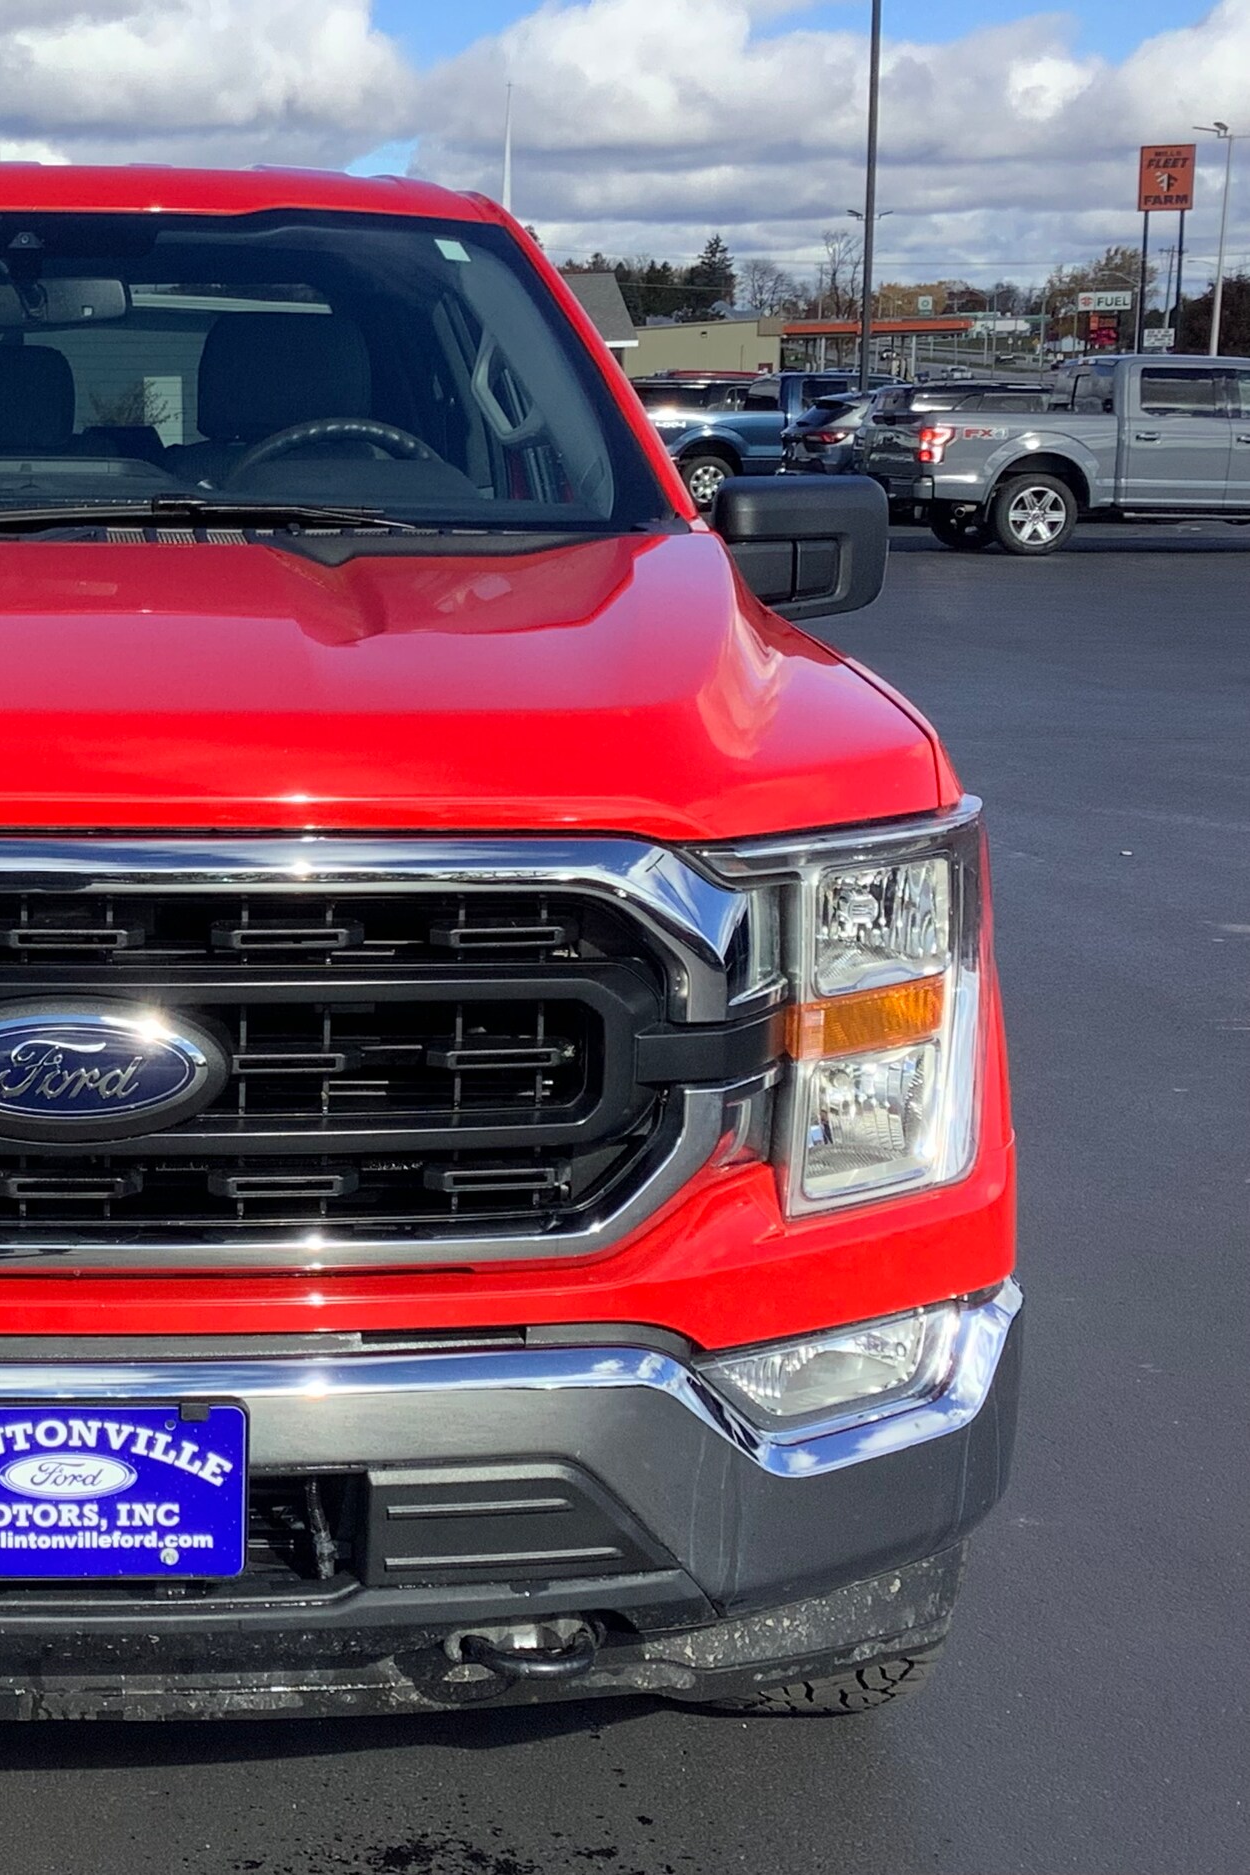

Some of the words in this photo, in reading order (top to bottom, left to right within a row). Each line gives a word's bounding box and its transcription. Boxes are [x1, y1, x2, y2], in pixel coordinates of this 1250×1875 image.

[1147, 157, 1189, 168] FLEET
[1144, 194, 1187, 206] FARM
[1097, 296, 1129, 307] FUEL
[964, 428, 1008, 439] FX4
[30, 1461, 104, 1488] Ford
[117, 1504, 179, 1527] INC
